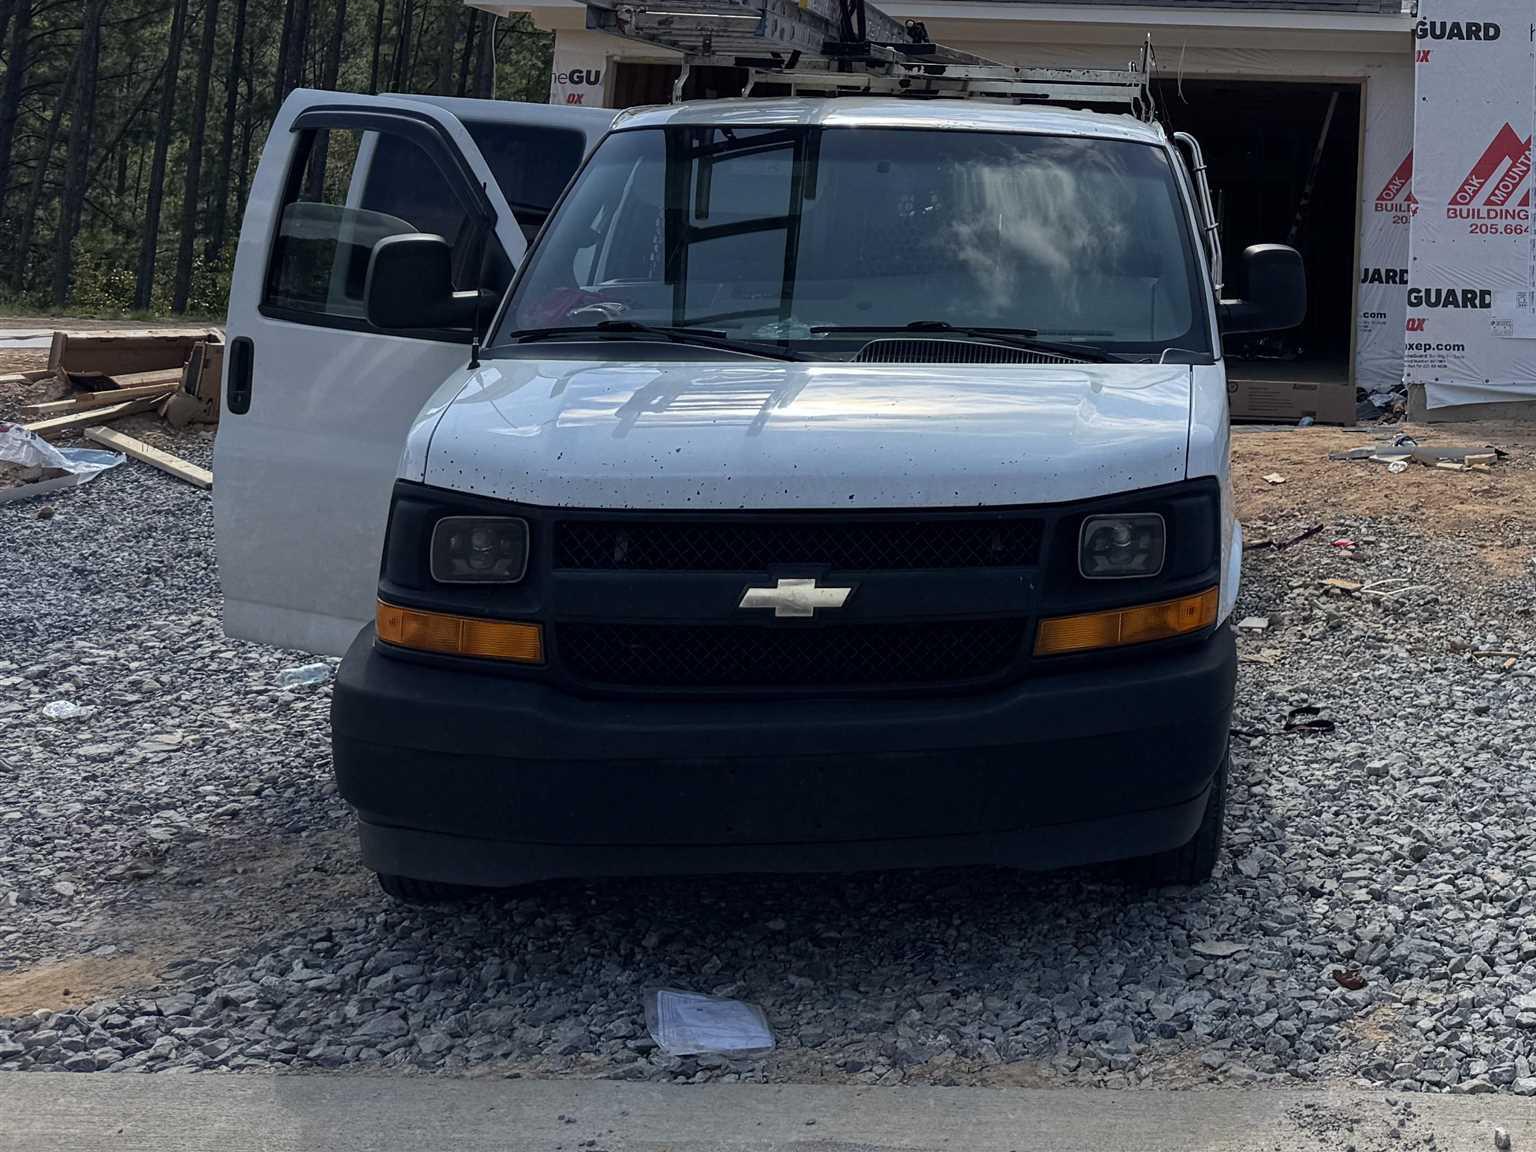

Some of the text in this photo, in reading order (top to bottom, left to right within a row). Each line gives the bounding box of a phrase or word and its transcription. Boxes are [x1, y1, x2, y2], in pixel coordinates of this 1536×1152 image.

[1416, 20, 1501, 40] GUARD
[567, 93, 584, 104] OX
[1382, 176, 1406, 200] OAK
[1457, 176, 1485, 203] OAK
[1446, 208, 1529, 220] BUILDING
[1406, 318, 1425, 332] OX
